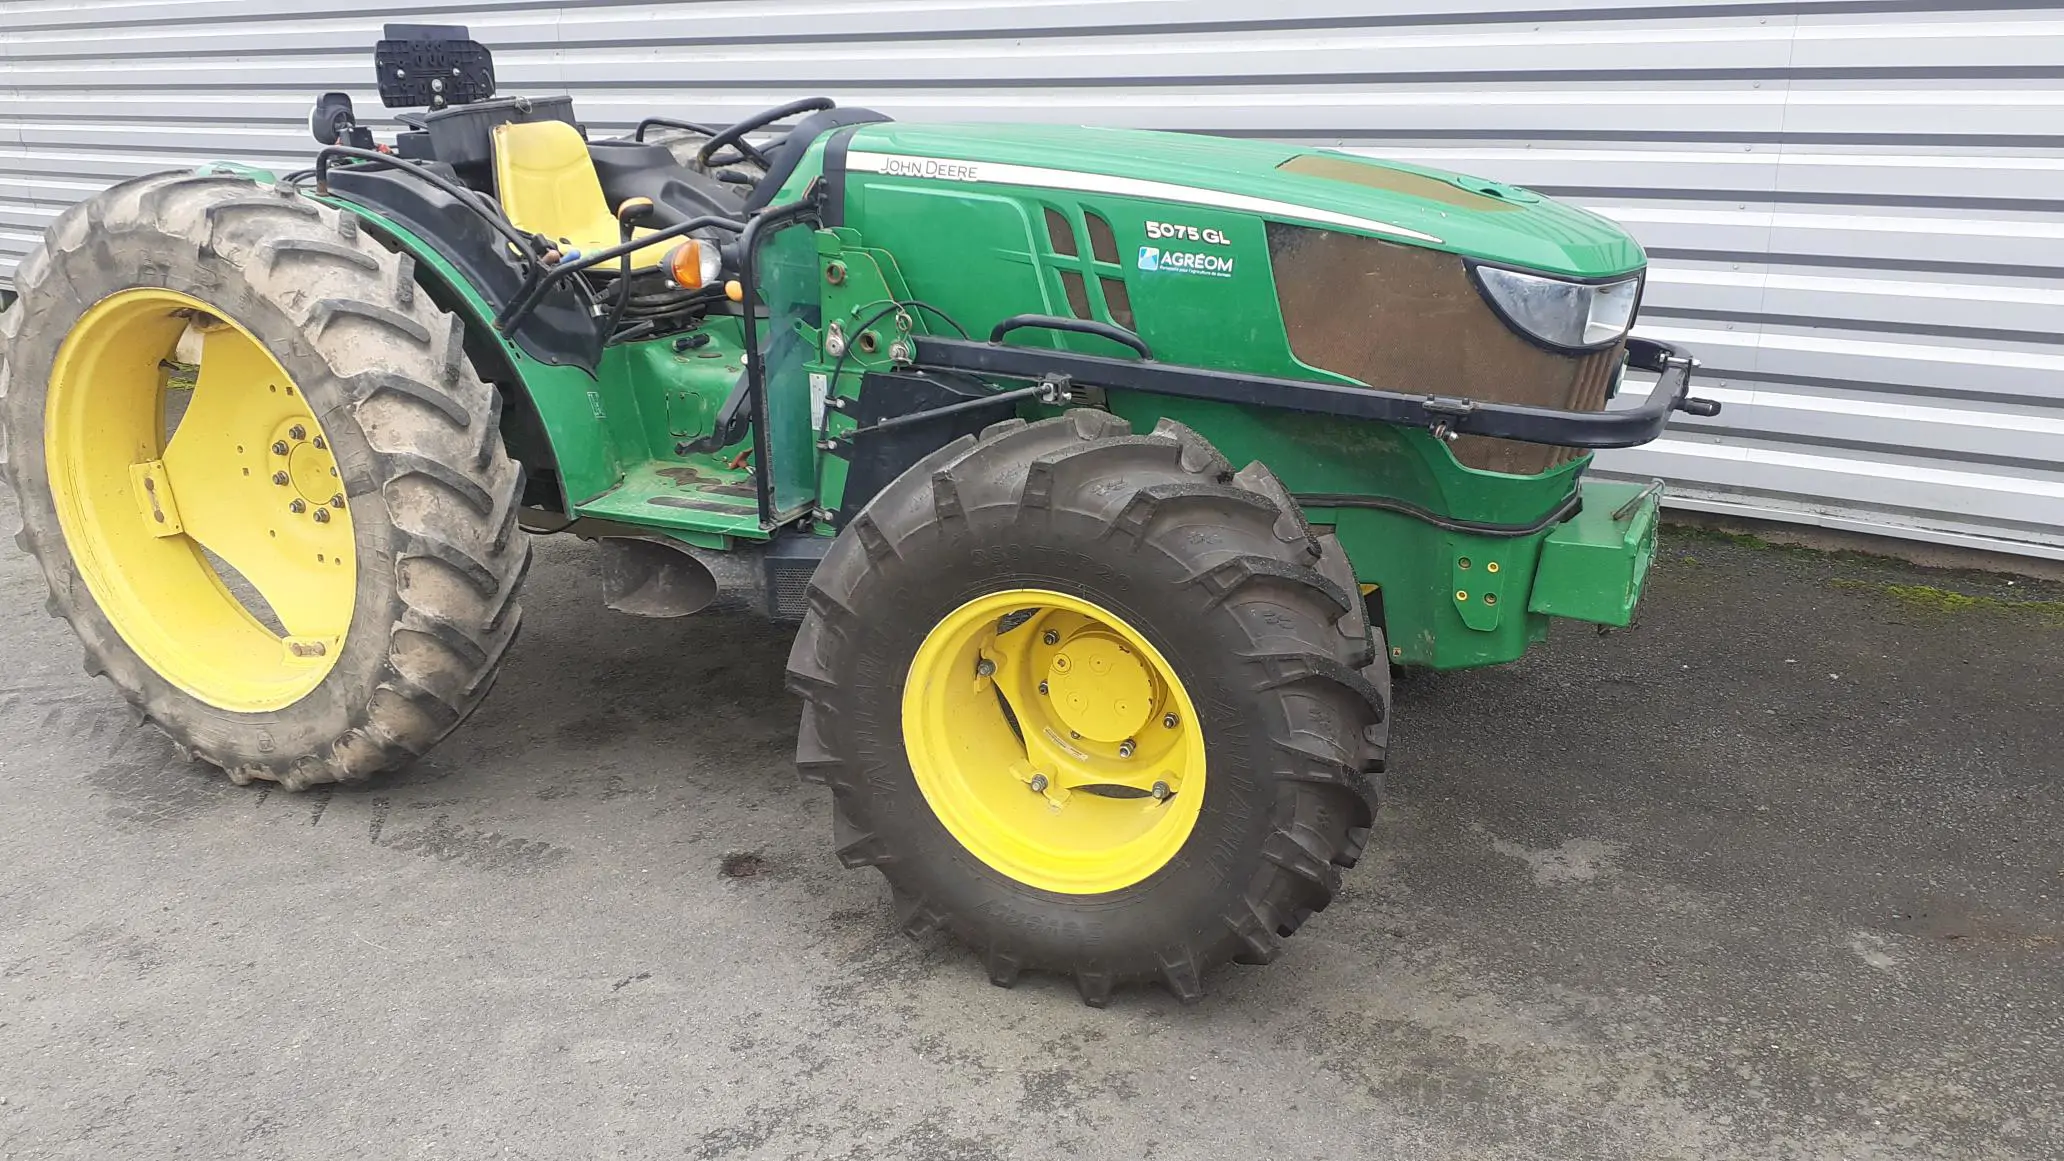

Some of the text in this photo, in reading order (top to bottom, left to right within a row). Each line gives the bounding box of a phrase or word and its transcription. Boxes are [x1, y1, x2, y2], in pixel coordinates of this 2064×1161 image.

[881, 157, 978, 178] JOHN DEERE
[1144, 220, 1232, 246] 5075 GL
[1160, 250, 1234, 272] AGRÉOM
